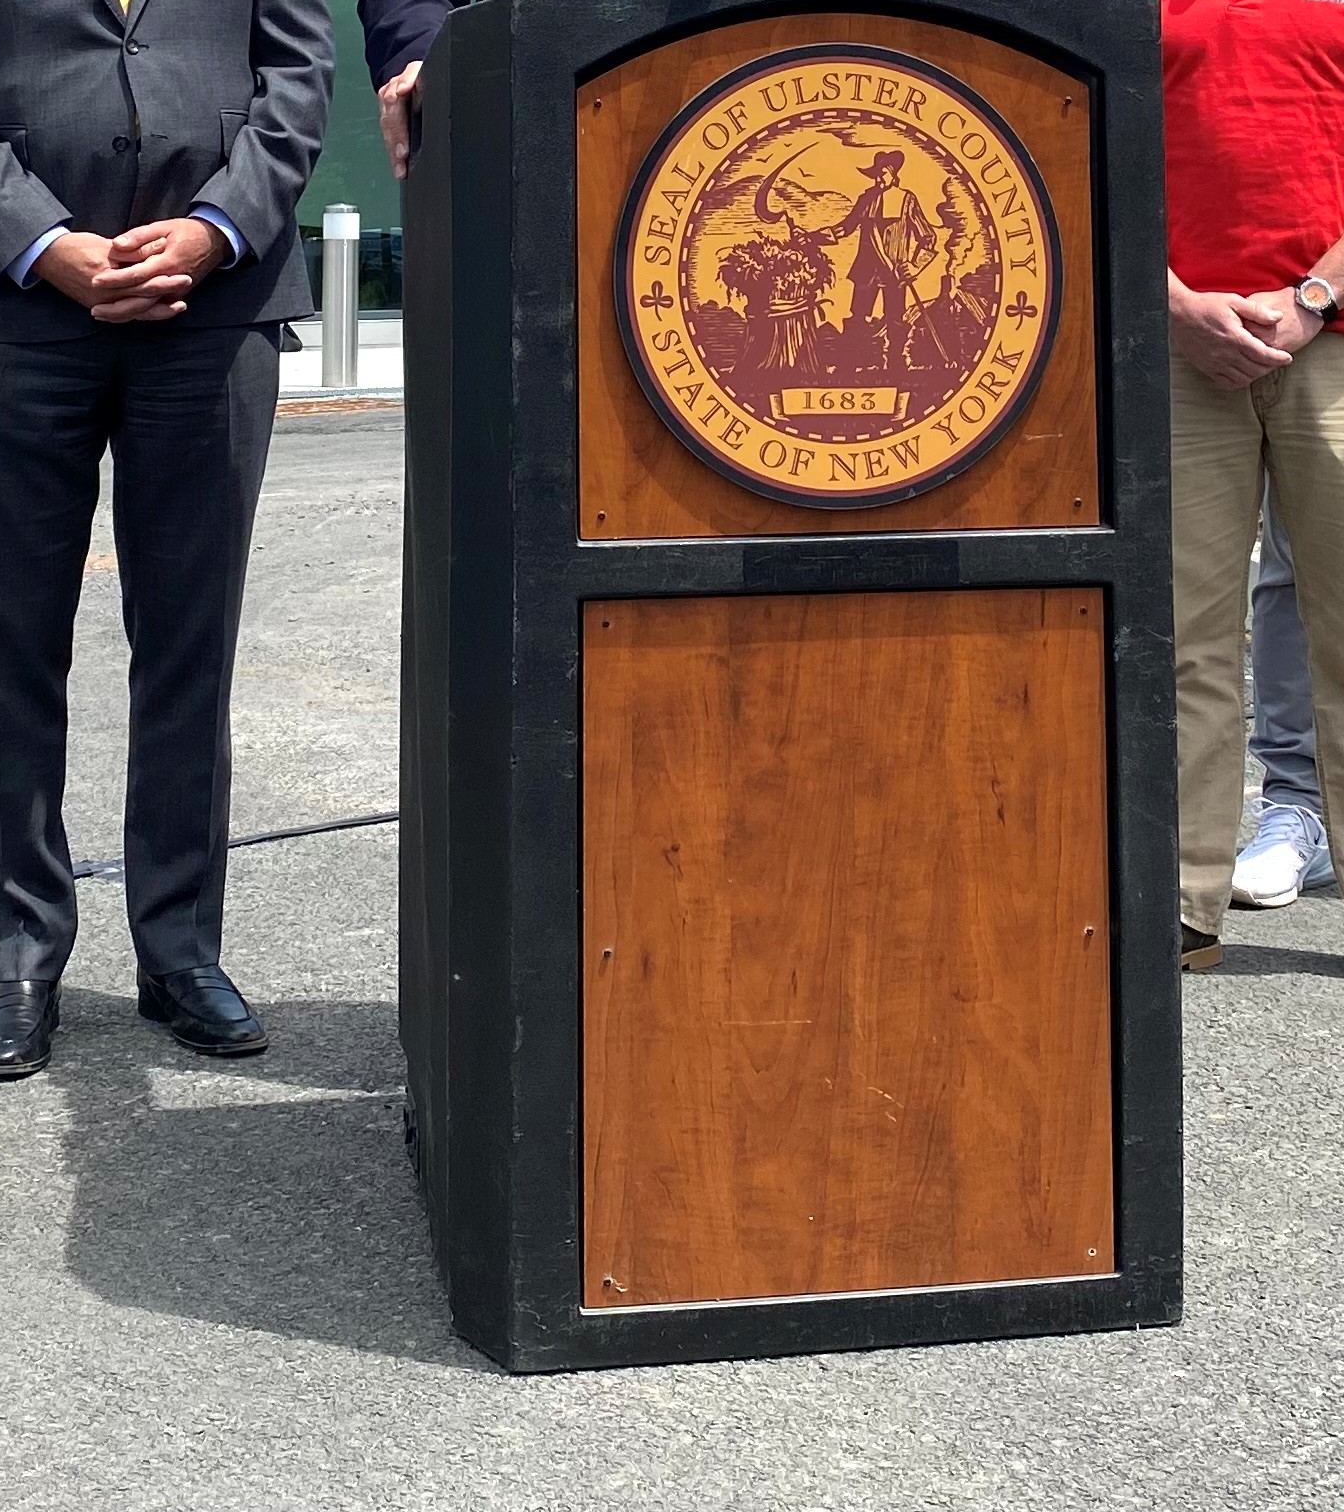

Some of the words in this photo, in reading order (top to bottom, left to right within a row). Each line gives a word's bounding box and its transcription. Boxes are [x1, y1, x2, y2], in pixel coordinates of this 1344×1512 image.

[644, 161, 706, 265] SEAL
[702, 101, 749, 151] OF
[758, 73, 927, 122] ULSTER
[937, 111, 1038, 278] COUNTY
[651, 329, 752, 450] STATE
[759, 439, 816, 476] OF
[828, 435, 921, 481] NEW
[930, 340, 1025, 446] YORK
[802, 391, 876, 410] 1683
